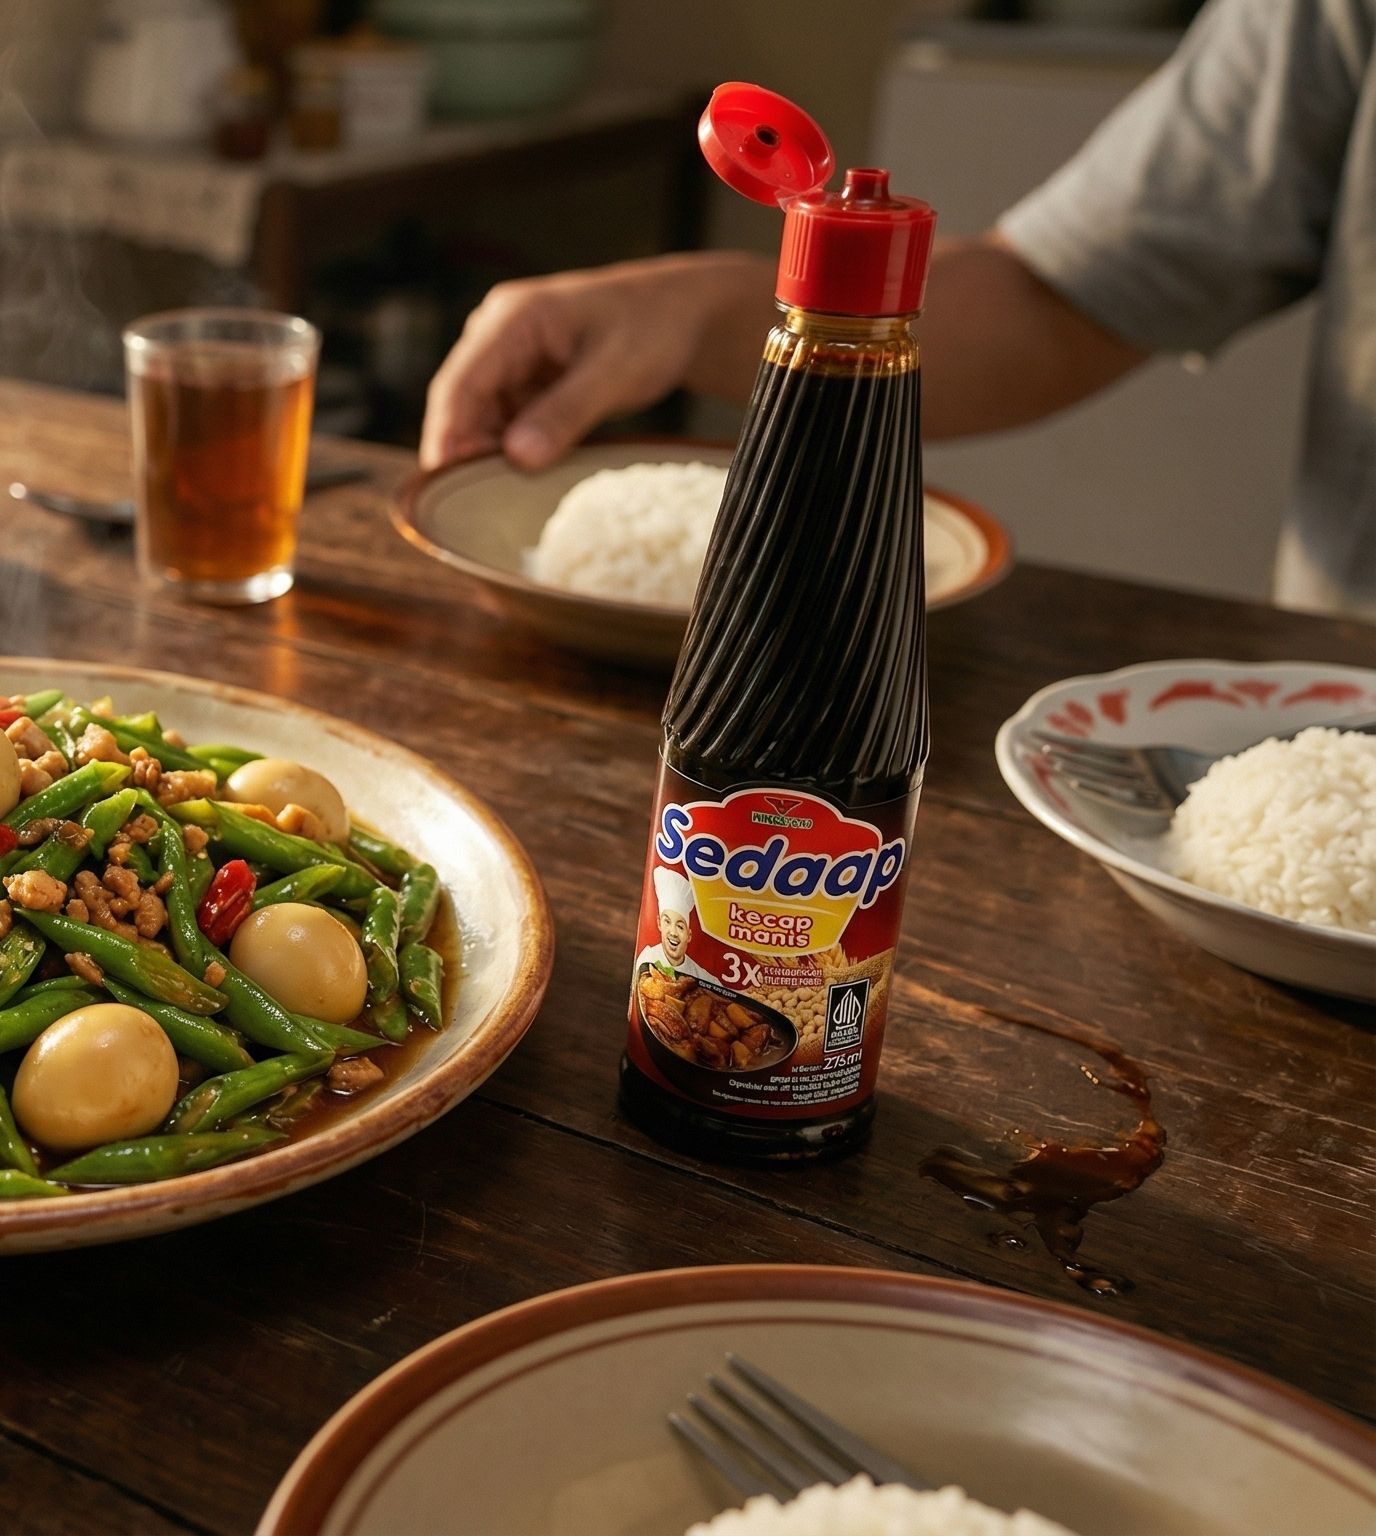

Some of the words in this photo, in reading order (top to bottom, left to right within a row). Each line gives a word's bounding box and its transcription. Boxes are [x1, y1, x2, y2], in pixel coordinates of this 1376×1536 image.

[657, 805, 903, 907] Sedaap
[730, 903, 812, 933] kecap
[730, 925, 809, 947] manis
